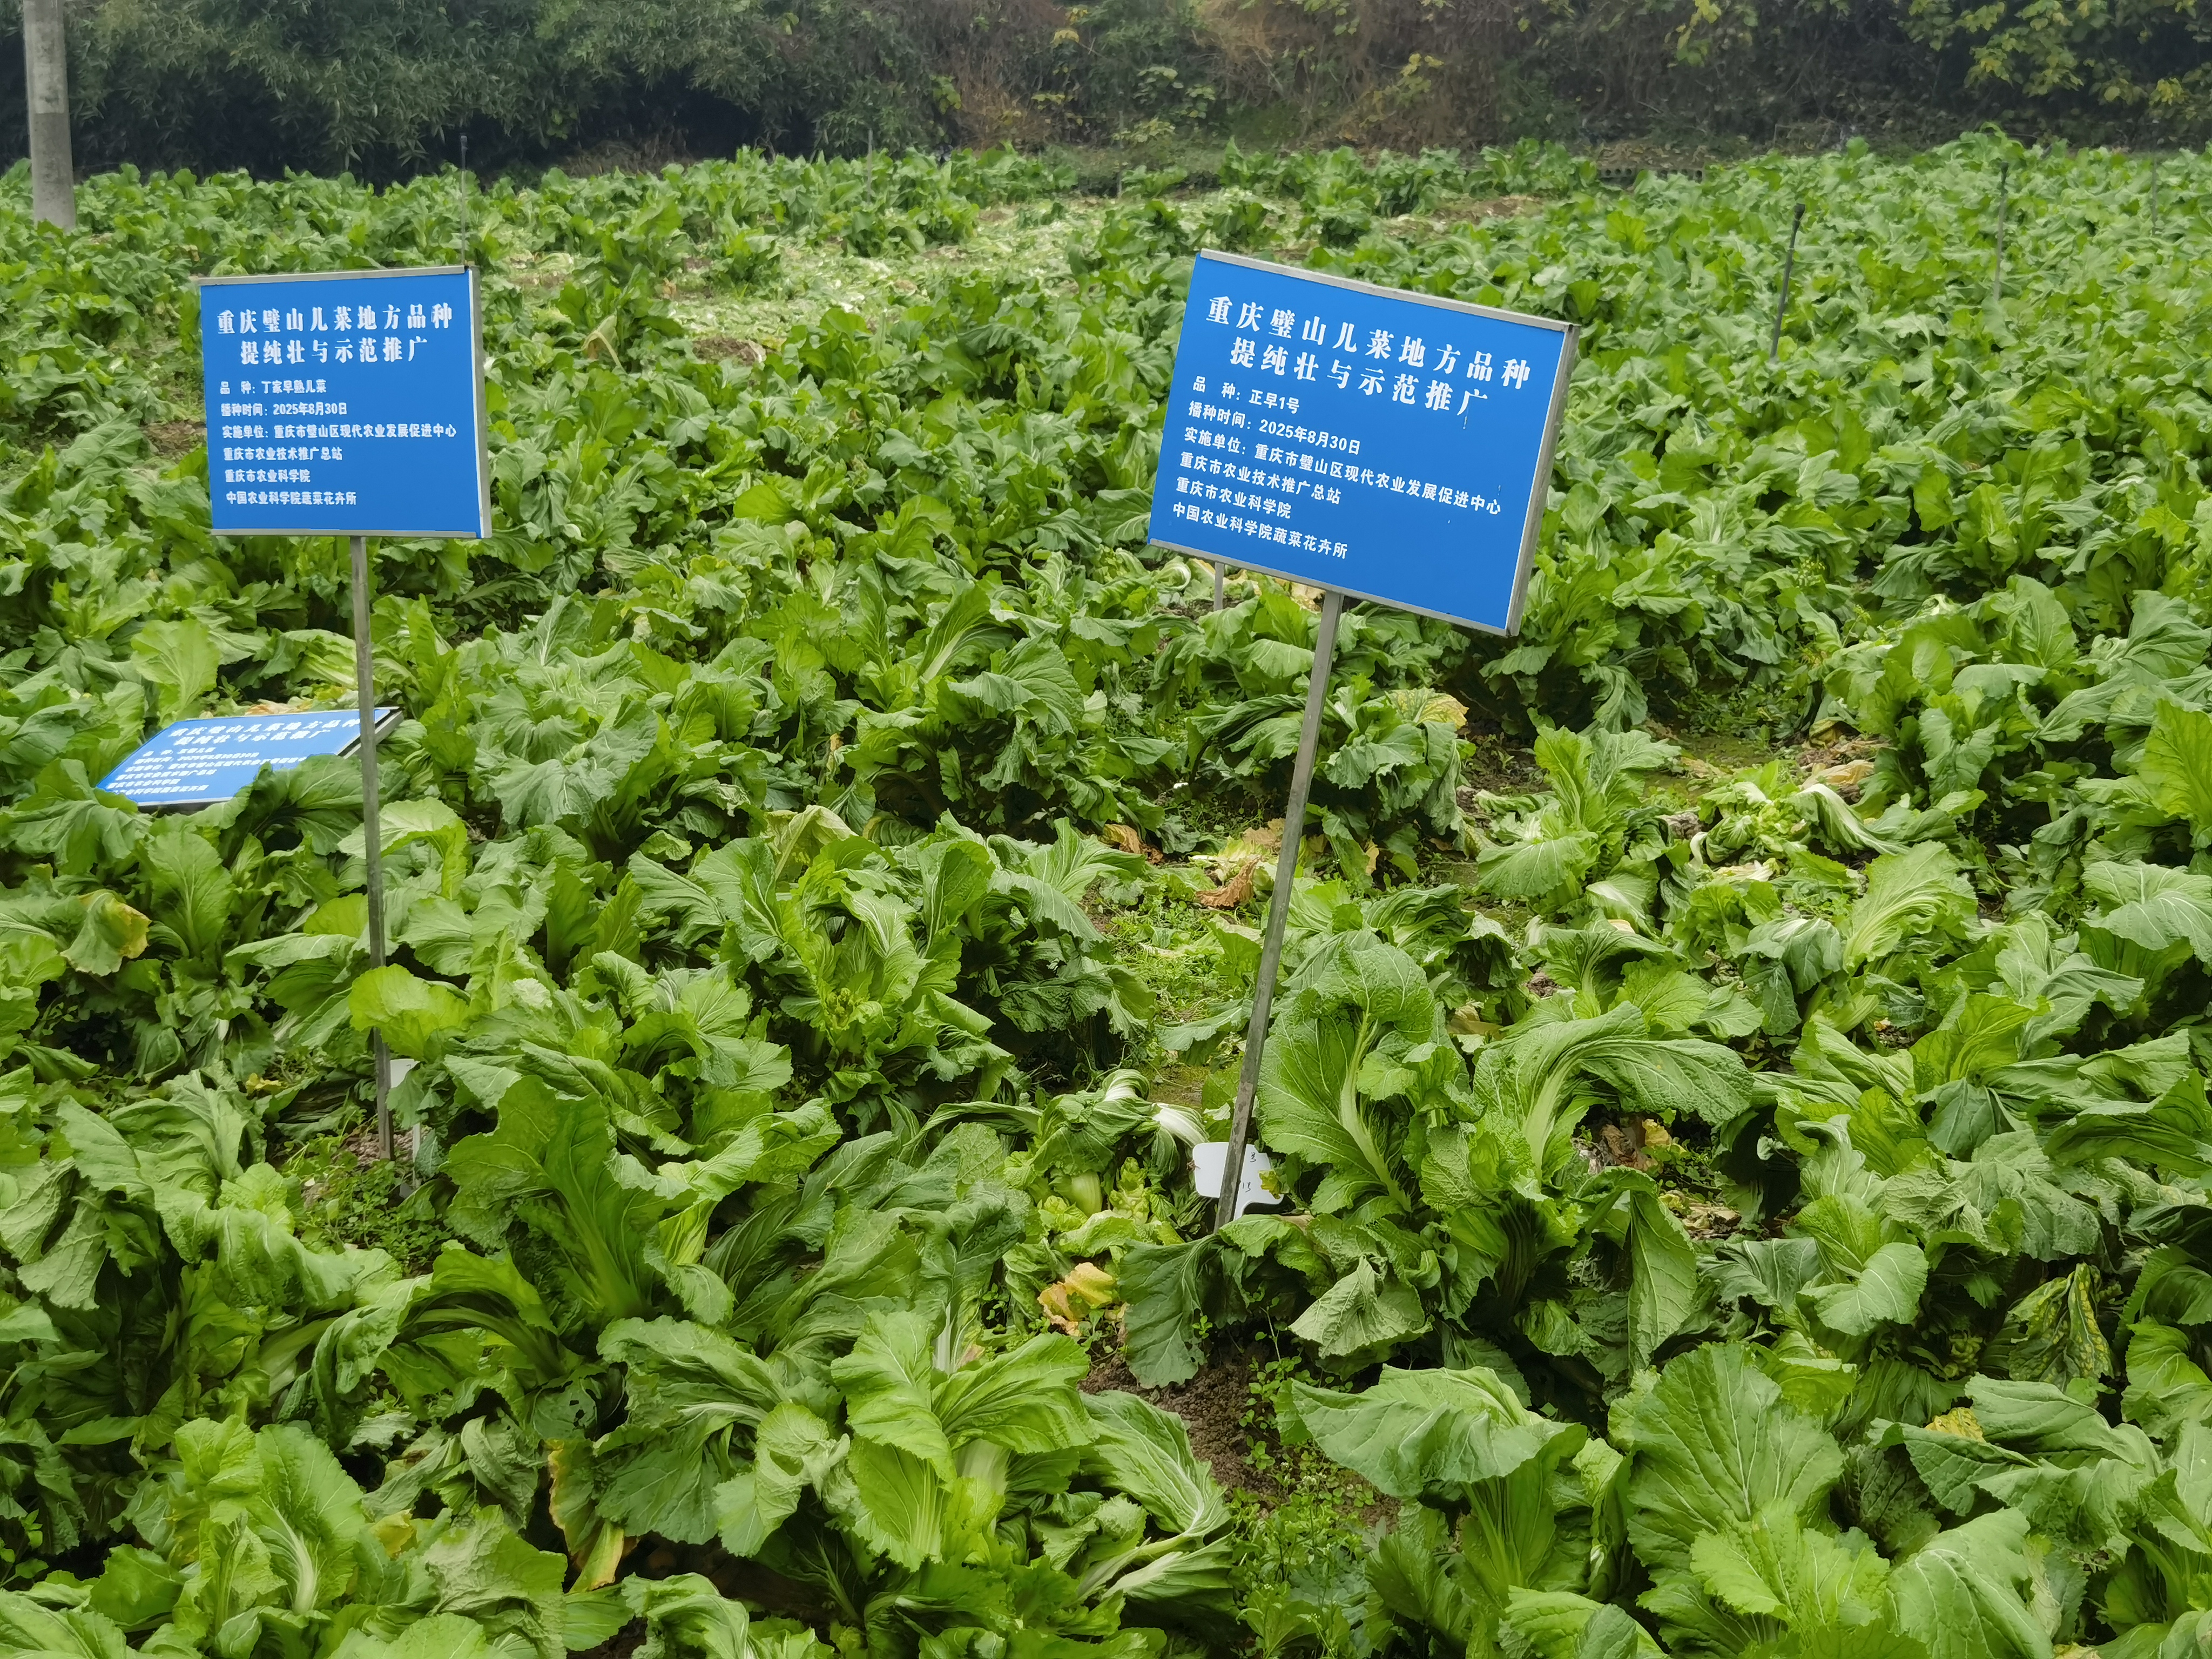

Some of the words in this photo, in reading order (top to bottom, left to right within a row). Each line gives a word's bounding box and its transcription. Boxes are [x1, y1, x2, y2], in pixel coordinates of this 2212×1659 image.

[217, 302, 453, 334] 重庆璧山儿菜地方品种
[240, 336, 428, 365] 提纯壮与示范推广
[1206, 295, 1531, 389] 重庆璧山儿菜地方品种
[1230, 336, 1488, 419] 提纯壮与示范推广
[223, 446, 342, 461] 重庆市农业技术推广总站
[225, 469, 311, 483] 重庆市农业科学院
[1179, 451, 1342, 505] 重庆市农业技术推广总站
[226, 491, 357, 505] 中国农业科学院蔬菜花卉所
[1176, 476, 1292, 519] 重庆市农业科学院
[1173, 501, 1348, 559] 中国农业科学院蔬菜花卉所
